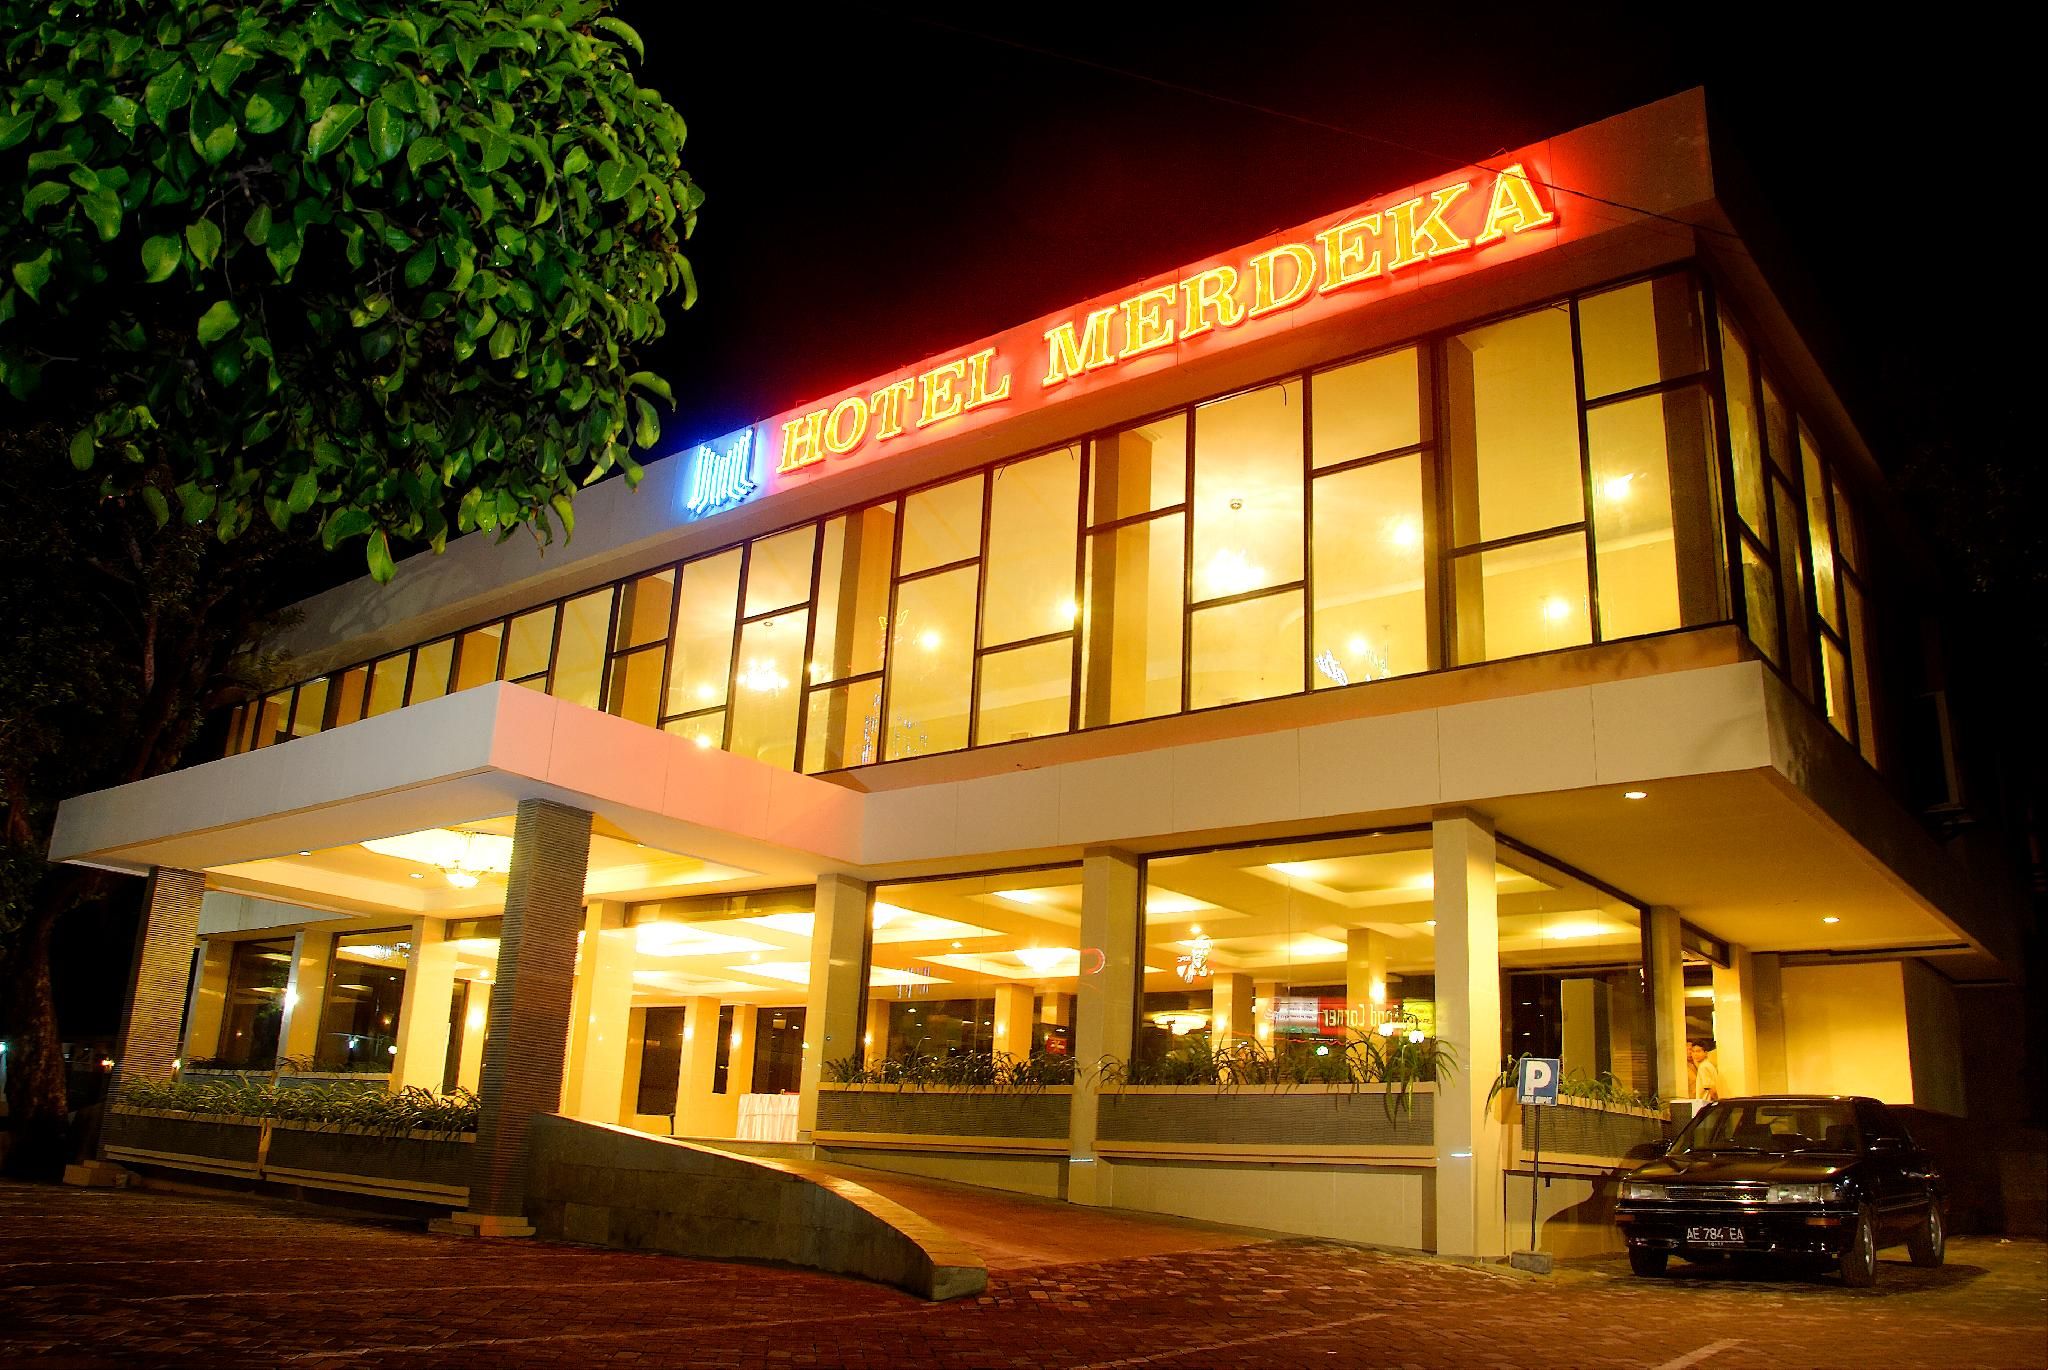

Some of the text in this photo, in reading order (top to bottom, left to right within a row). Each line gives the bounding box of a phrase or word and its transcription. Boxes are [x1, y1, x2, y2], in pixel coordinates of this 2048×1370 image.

[776, 162, 1555, 474] HOTEL MERDEKA
[1525, 1060, 1551, 1095] P
[1686, 1227, 1744, 1240] AE 784 EA
